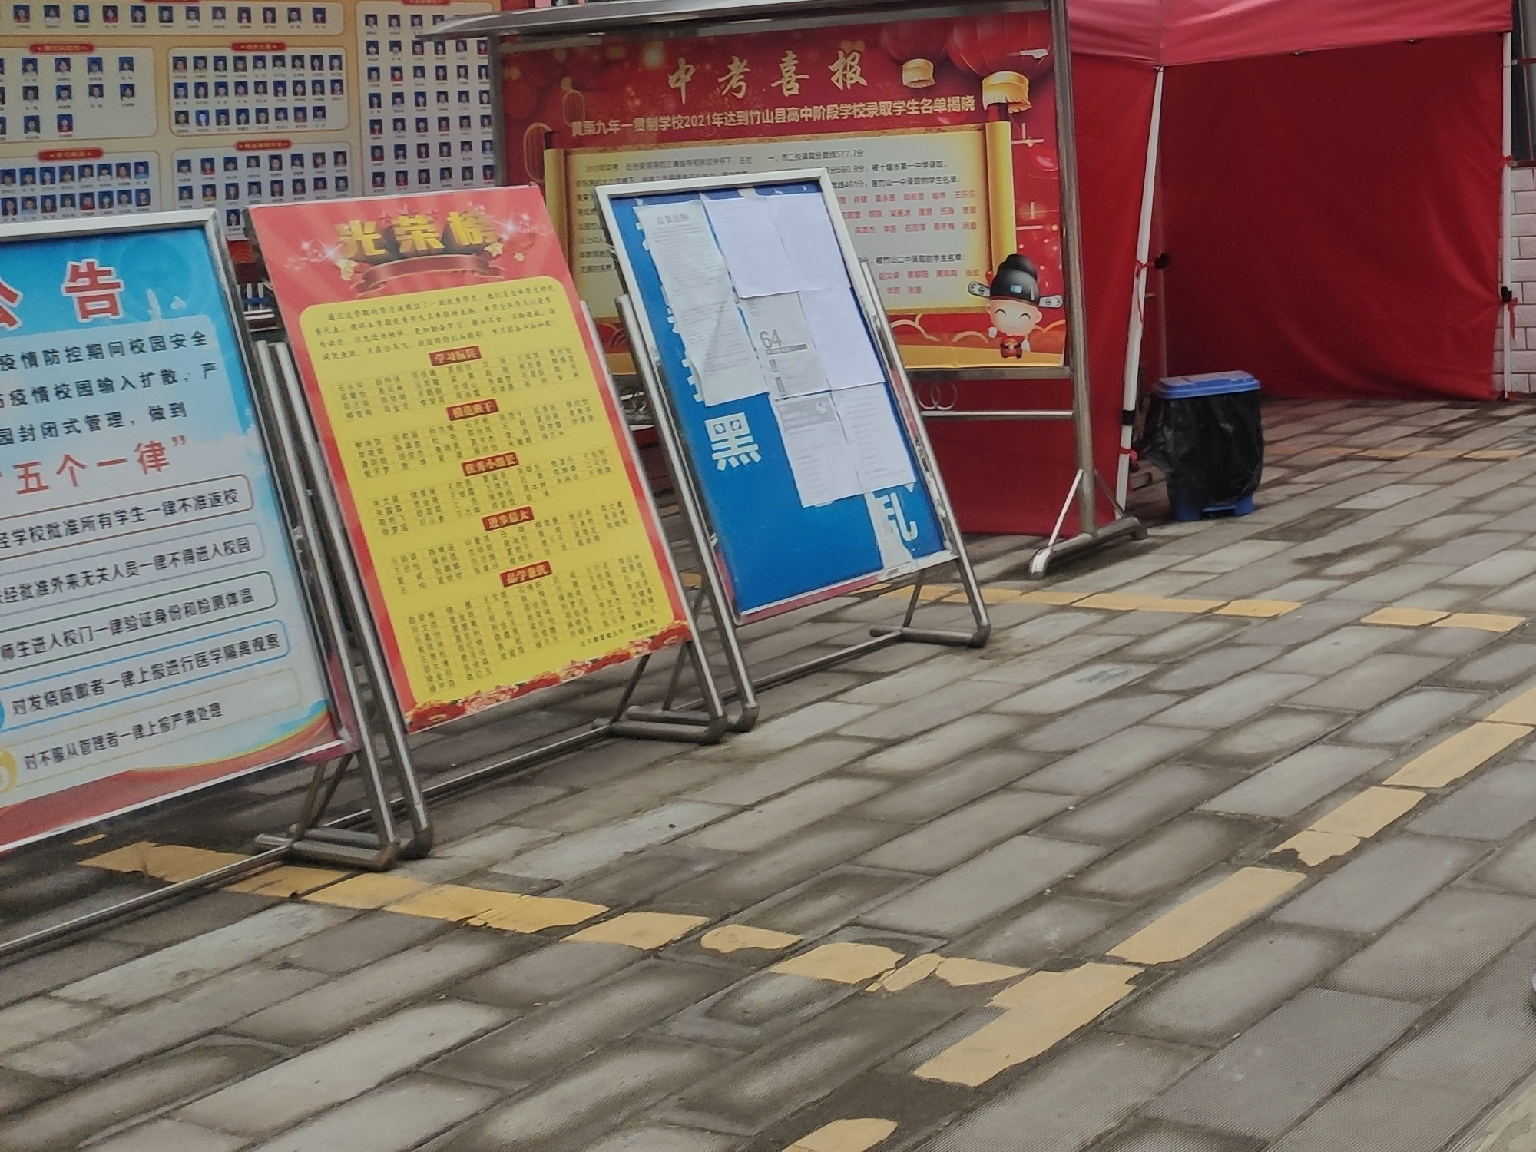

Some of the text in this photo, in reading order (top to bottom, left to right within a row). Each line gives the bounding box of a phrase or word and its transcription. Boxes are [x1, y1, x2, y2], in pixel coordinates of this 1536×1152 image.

[667, 50, 868, 105] 中考喜报
[336, 210, 496, 256] 光荣榜
[760, 329, 783, 349] 64
[0, 361, 218, 409] 疫情校园输入扩散，严
[704, 412, 762, 471] 黑
[0, 536, 251, 605] 经批准外来无关人员一律不得进入校园
